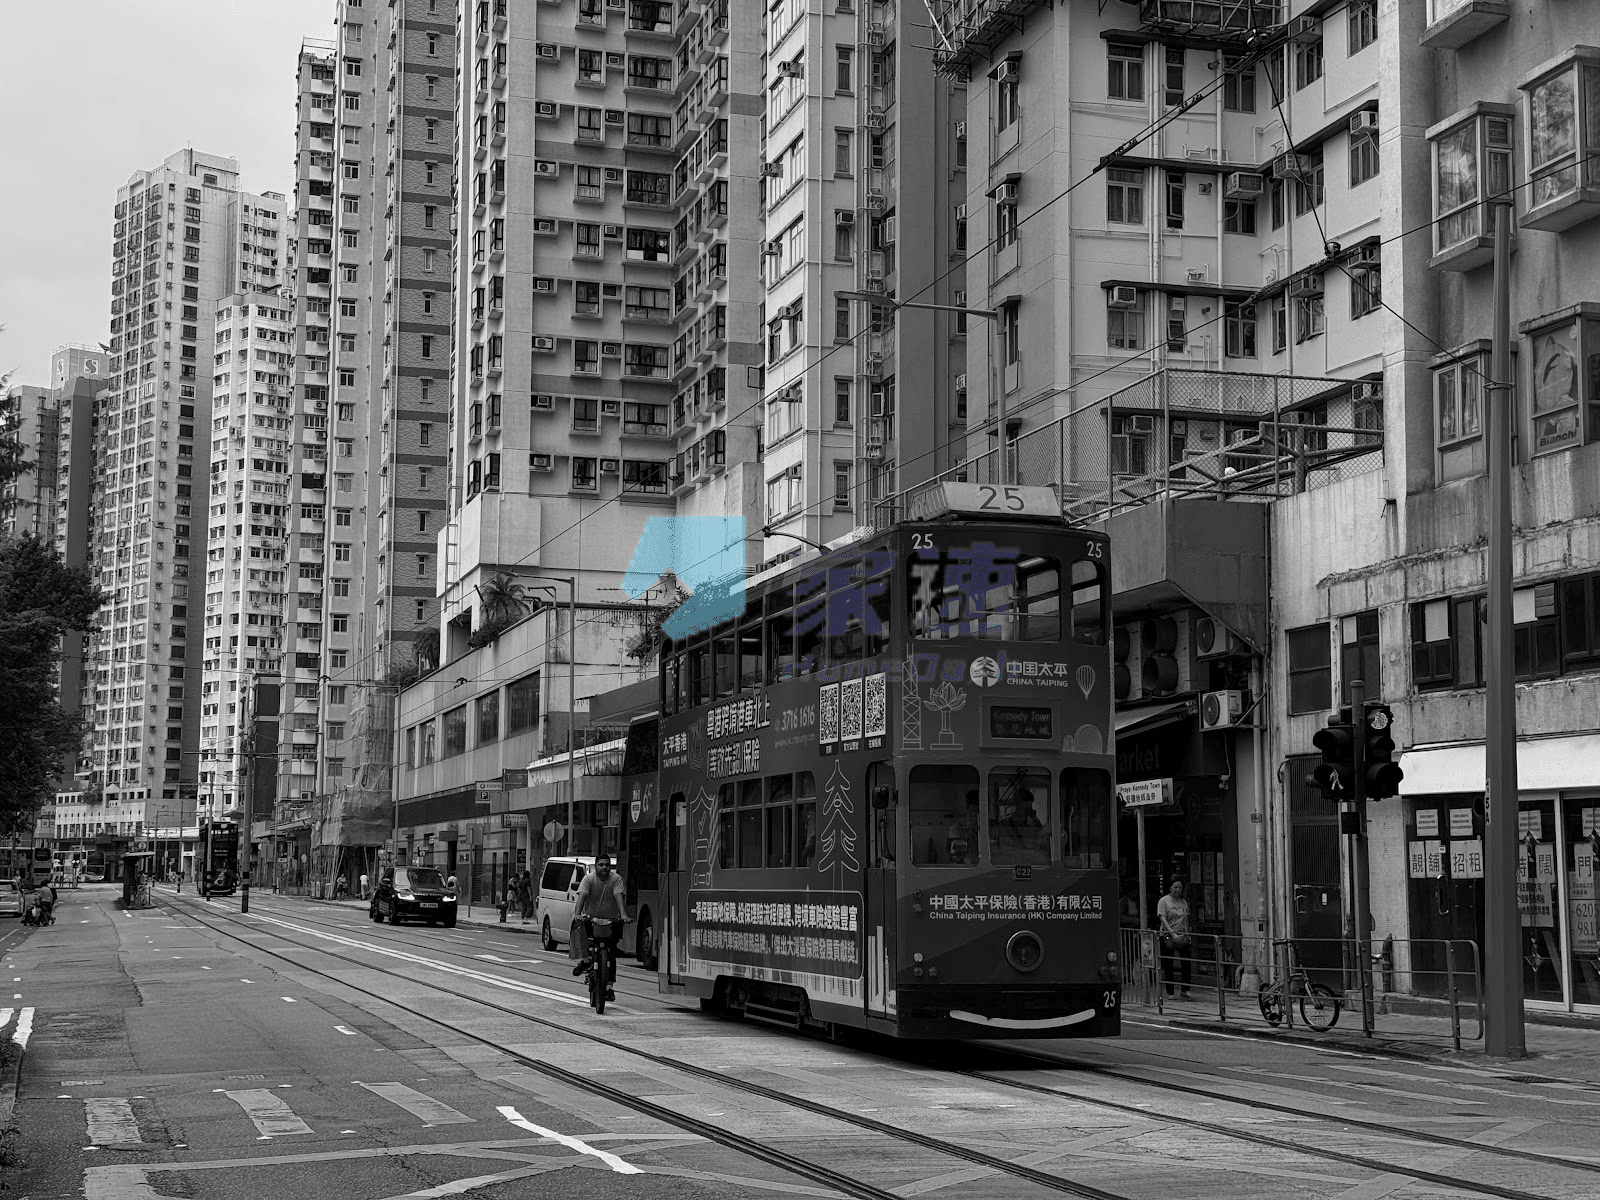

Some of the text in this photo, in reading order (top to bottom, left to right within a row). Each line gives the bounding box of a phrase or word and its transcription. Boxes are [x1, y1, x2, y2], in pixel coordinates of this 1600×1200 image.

[1539, 428, 1577, 447] Bianchi
[979, 485, 1025, 512] 25
[911, 532, 934, 551] 25
[1086, 540, 1102, 559] 25
[1006, 660, 1068, 677] 中国太平
[1006, 677, 1069, 688] CHINA TAIPING
[781, 704, 815, 732] 3716 1616
[992, 710, 1051, 723] Kennedy Town
[662, 731, 687, 756] 太平香港
[663, 754, 688, 769] TAIPING HK
[1118, 743, 1160, 774] arket
[1150, 782, 1161, 790] Town
[929, 911, 1103, 921] China Taiping Insurance (HK) Company Limited
[1103, 990, 1117, 1009] 25
